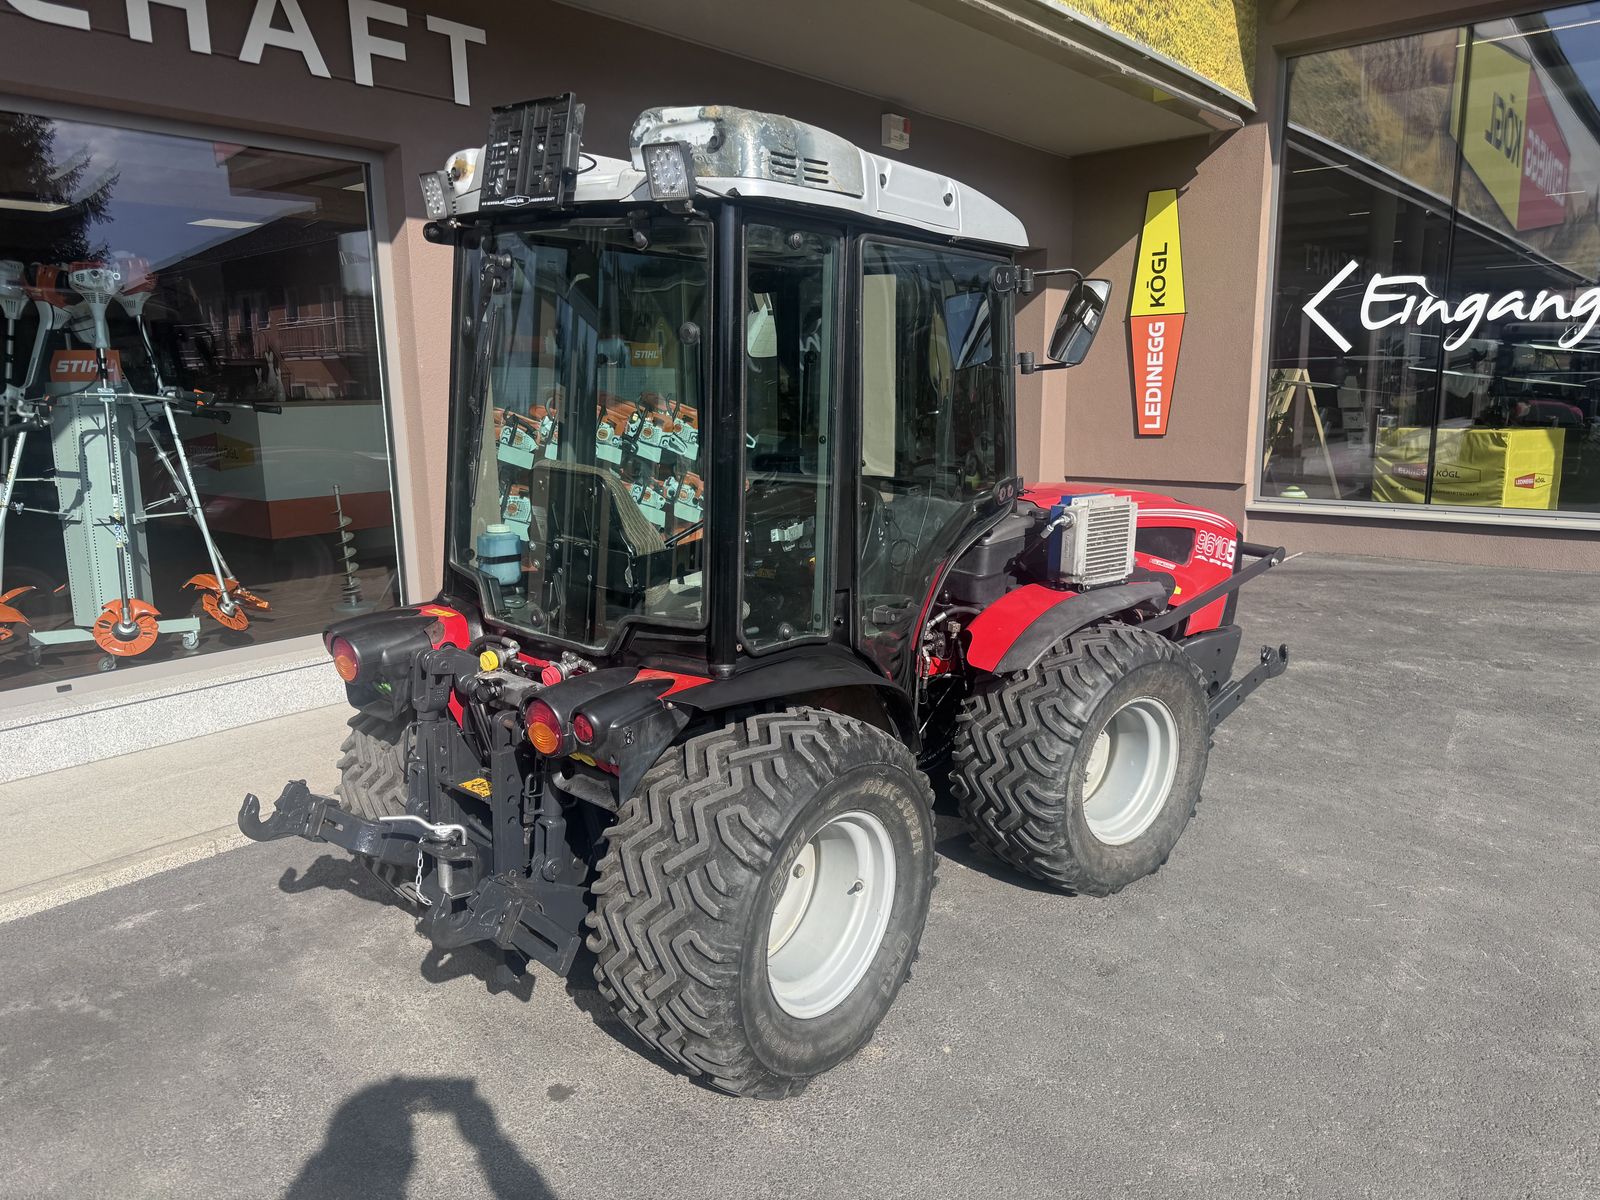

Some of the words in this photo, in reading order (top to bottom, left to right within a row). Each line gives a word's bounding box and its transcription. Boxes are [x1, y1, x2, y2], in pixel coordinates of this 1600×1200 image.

[1360, 272, 1600, 351] Eingang
[634, 350, 658, 359] STIHL
[1144, 321, 1165, 429] LEDINEGG
